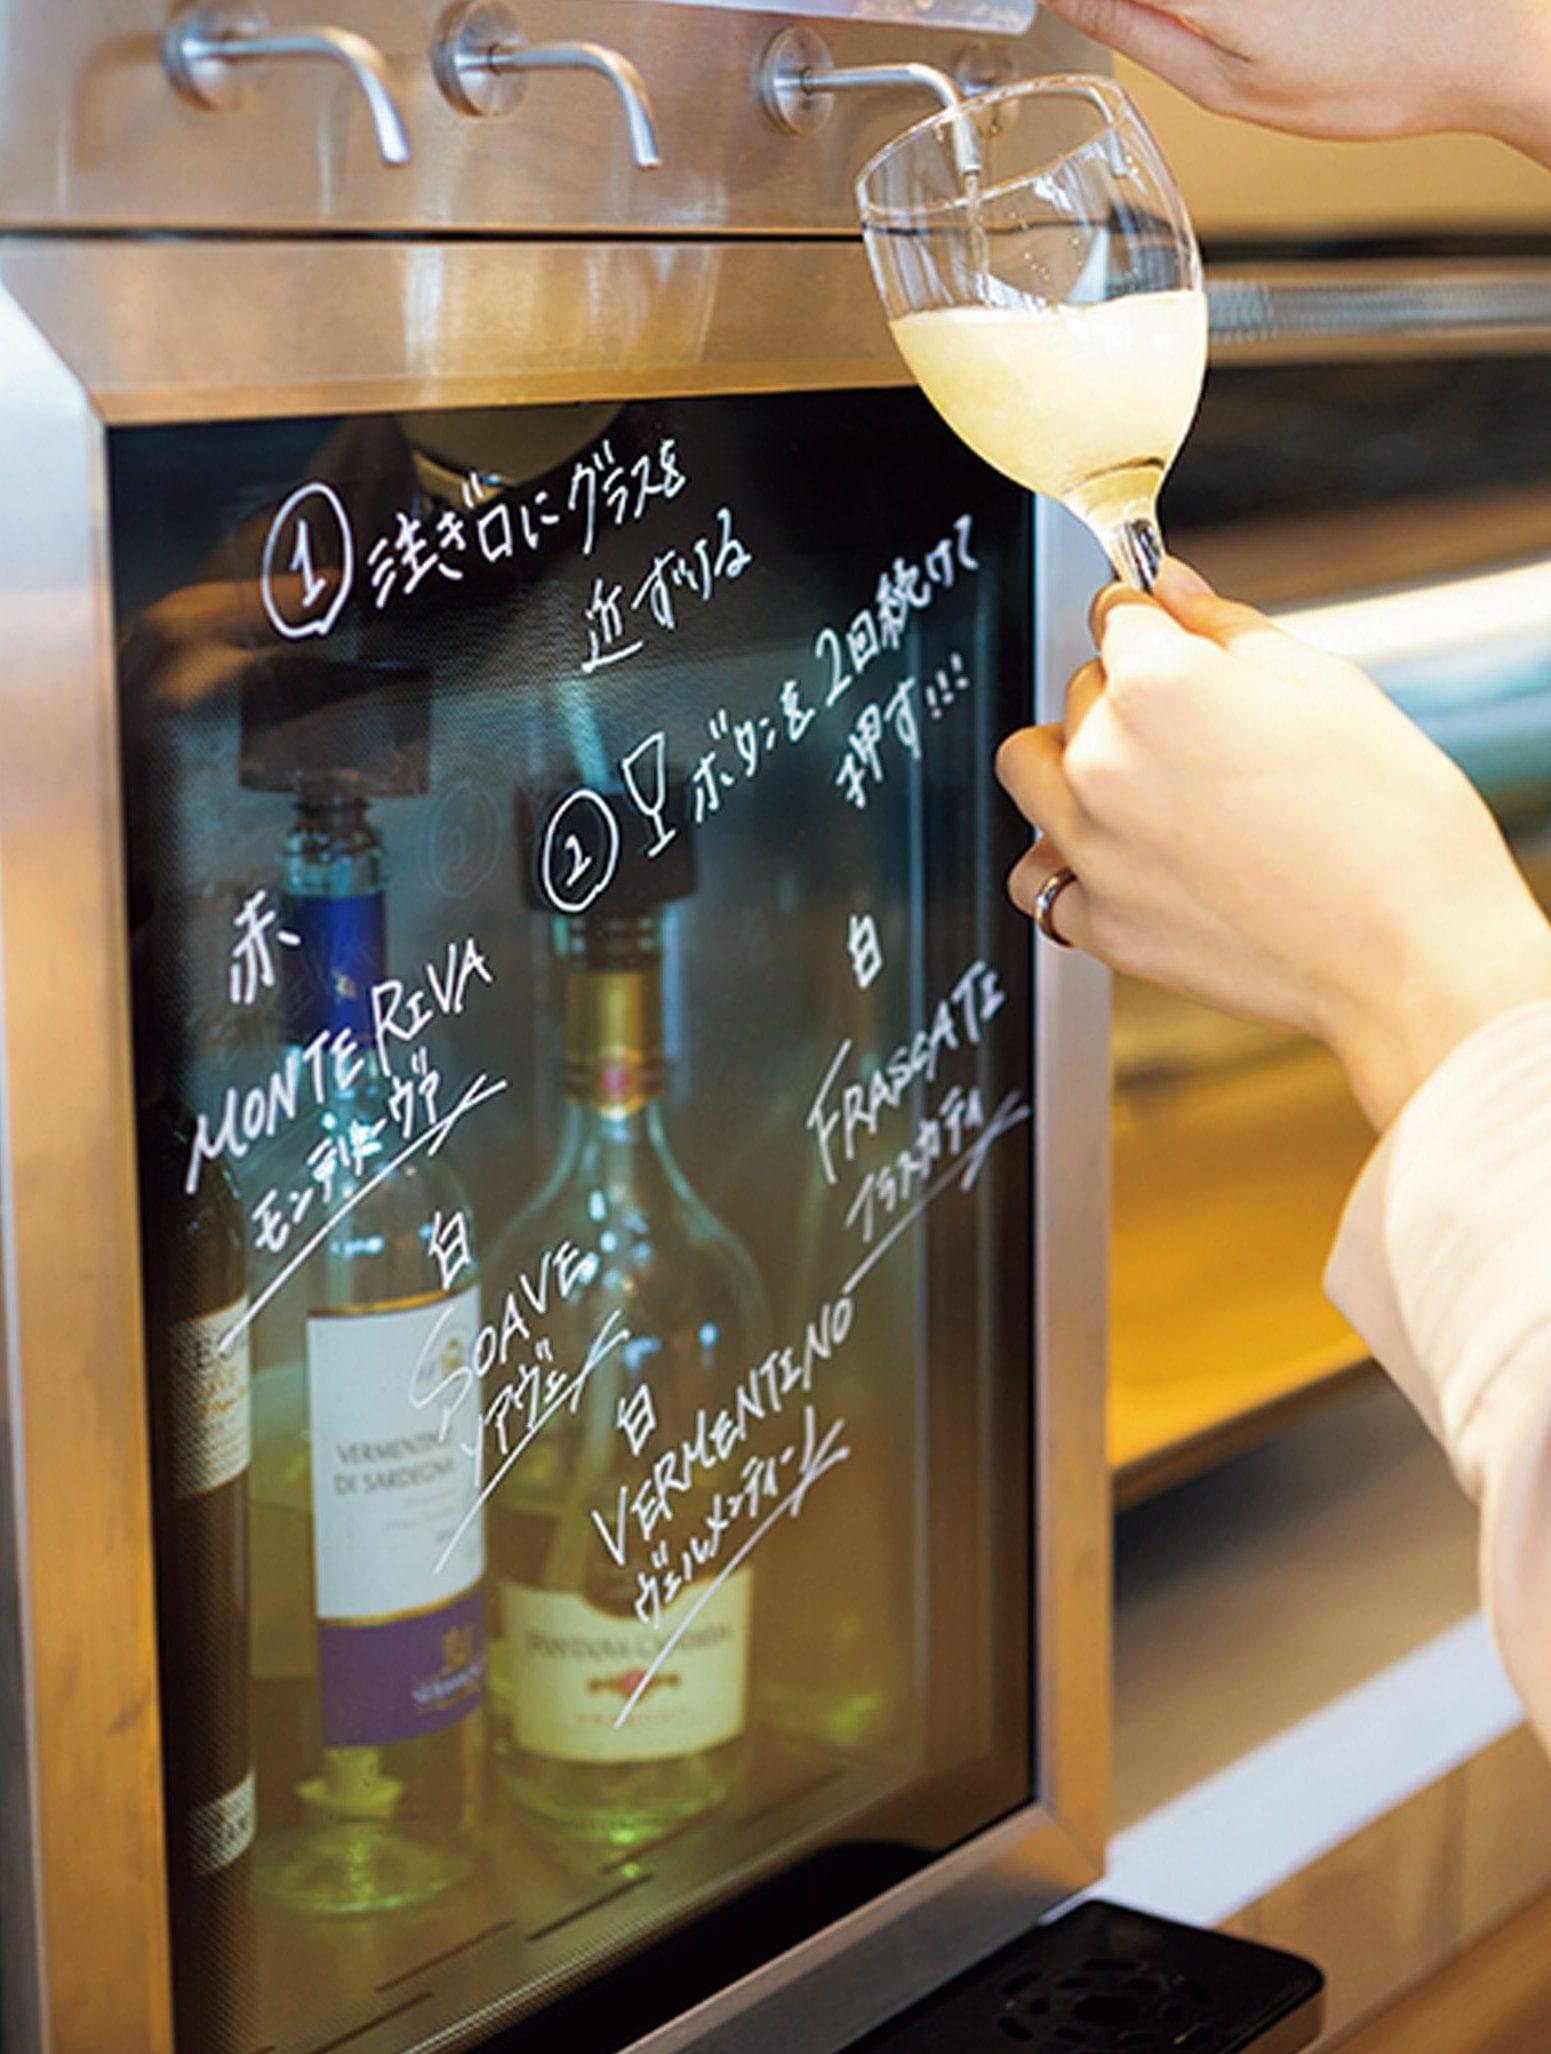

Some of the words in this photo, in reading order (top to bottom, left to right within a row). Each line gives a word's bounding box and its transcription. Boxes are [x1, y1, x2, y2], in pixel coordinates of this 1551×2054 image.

[230, 889, 302, 1004] 赤
[848, 913, 884, 989] 白
[186, 1027, 365, 1195] MONTE
[371, 937, 494, 1077] RIVA
[427, 1210, 473, 1291] 白
[409, 1240, 593, 1443] SOAVE
[591, 1297, 854, 1567] VERMENTINO
[616, 1383, 657, 1457] 白
